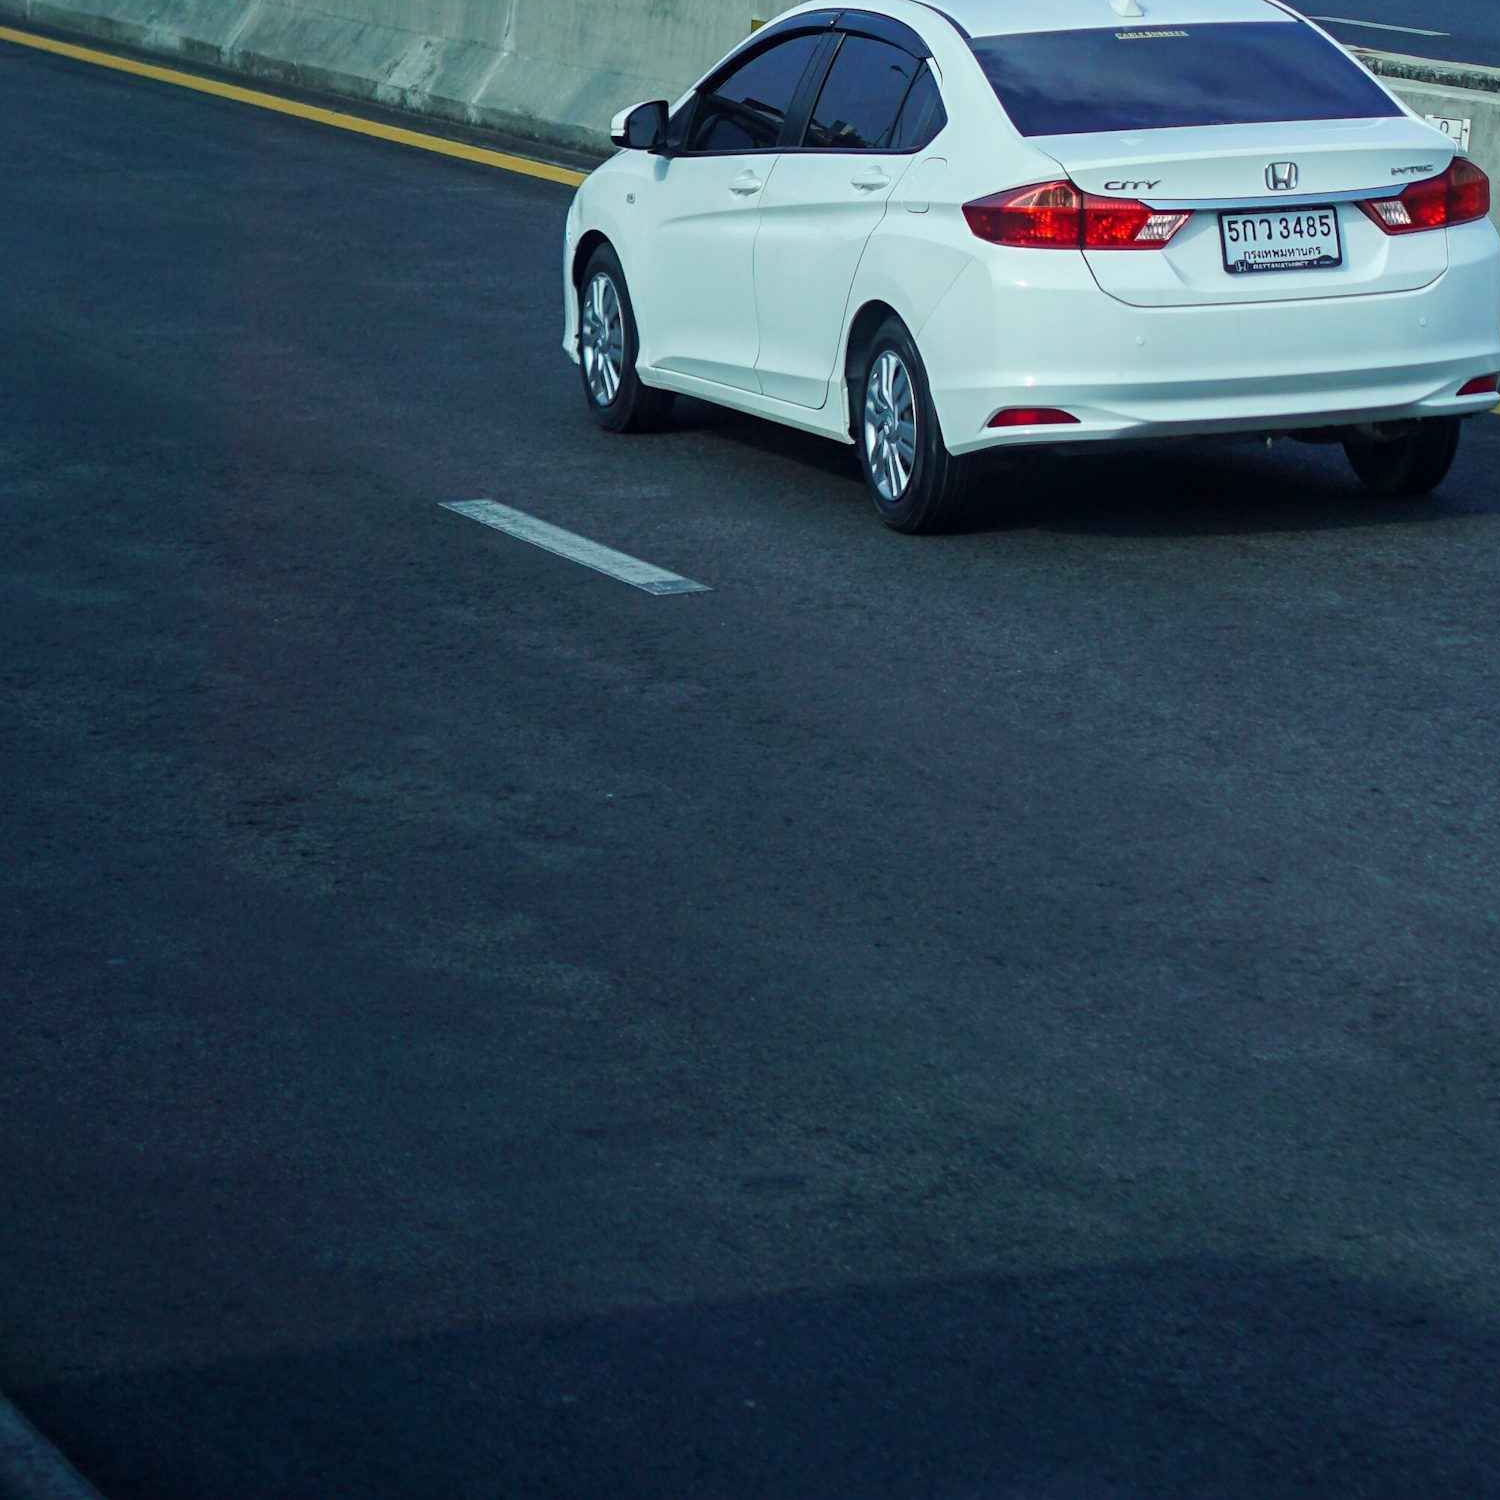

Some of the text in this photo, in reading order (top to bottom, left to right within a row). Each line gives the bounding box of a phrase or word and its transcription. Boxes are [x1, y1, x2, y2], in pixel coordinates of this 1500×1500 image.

[1104, 179, 1161, 191] CITY
[1227, 214, 1331, 242] 5กว 3485
[1243, 246, 1322, 263] กรุงเทพมหานคร
